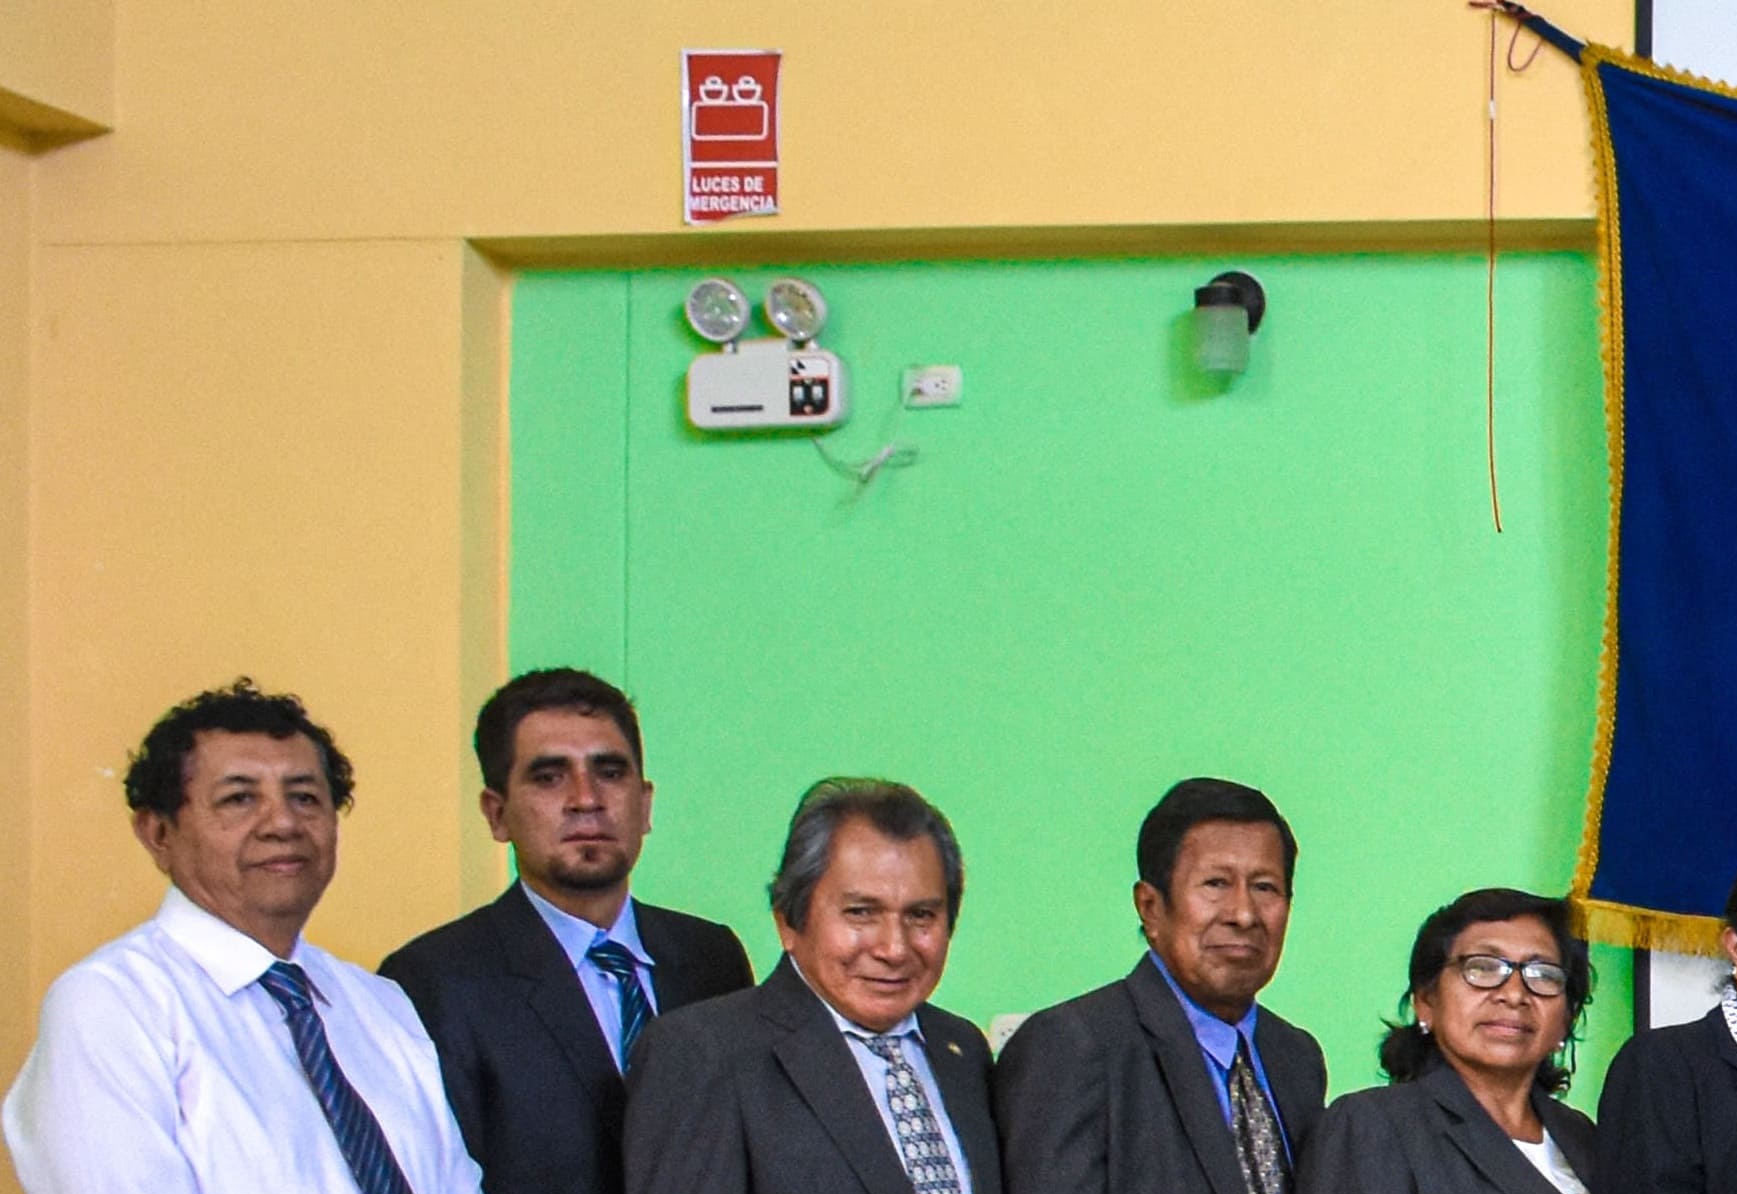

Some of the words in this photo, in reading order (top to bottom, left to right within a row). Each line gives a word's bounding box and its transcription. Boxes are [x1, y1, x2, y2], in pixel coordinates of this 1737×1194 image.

[692, 175, 740, 193] LUCES
[743, 175, 765, 193] DE
[691, 195, 775, 212] MERGENCIA
